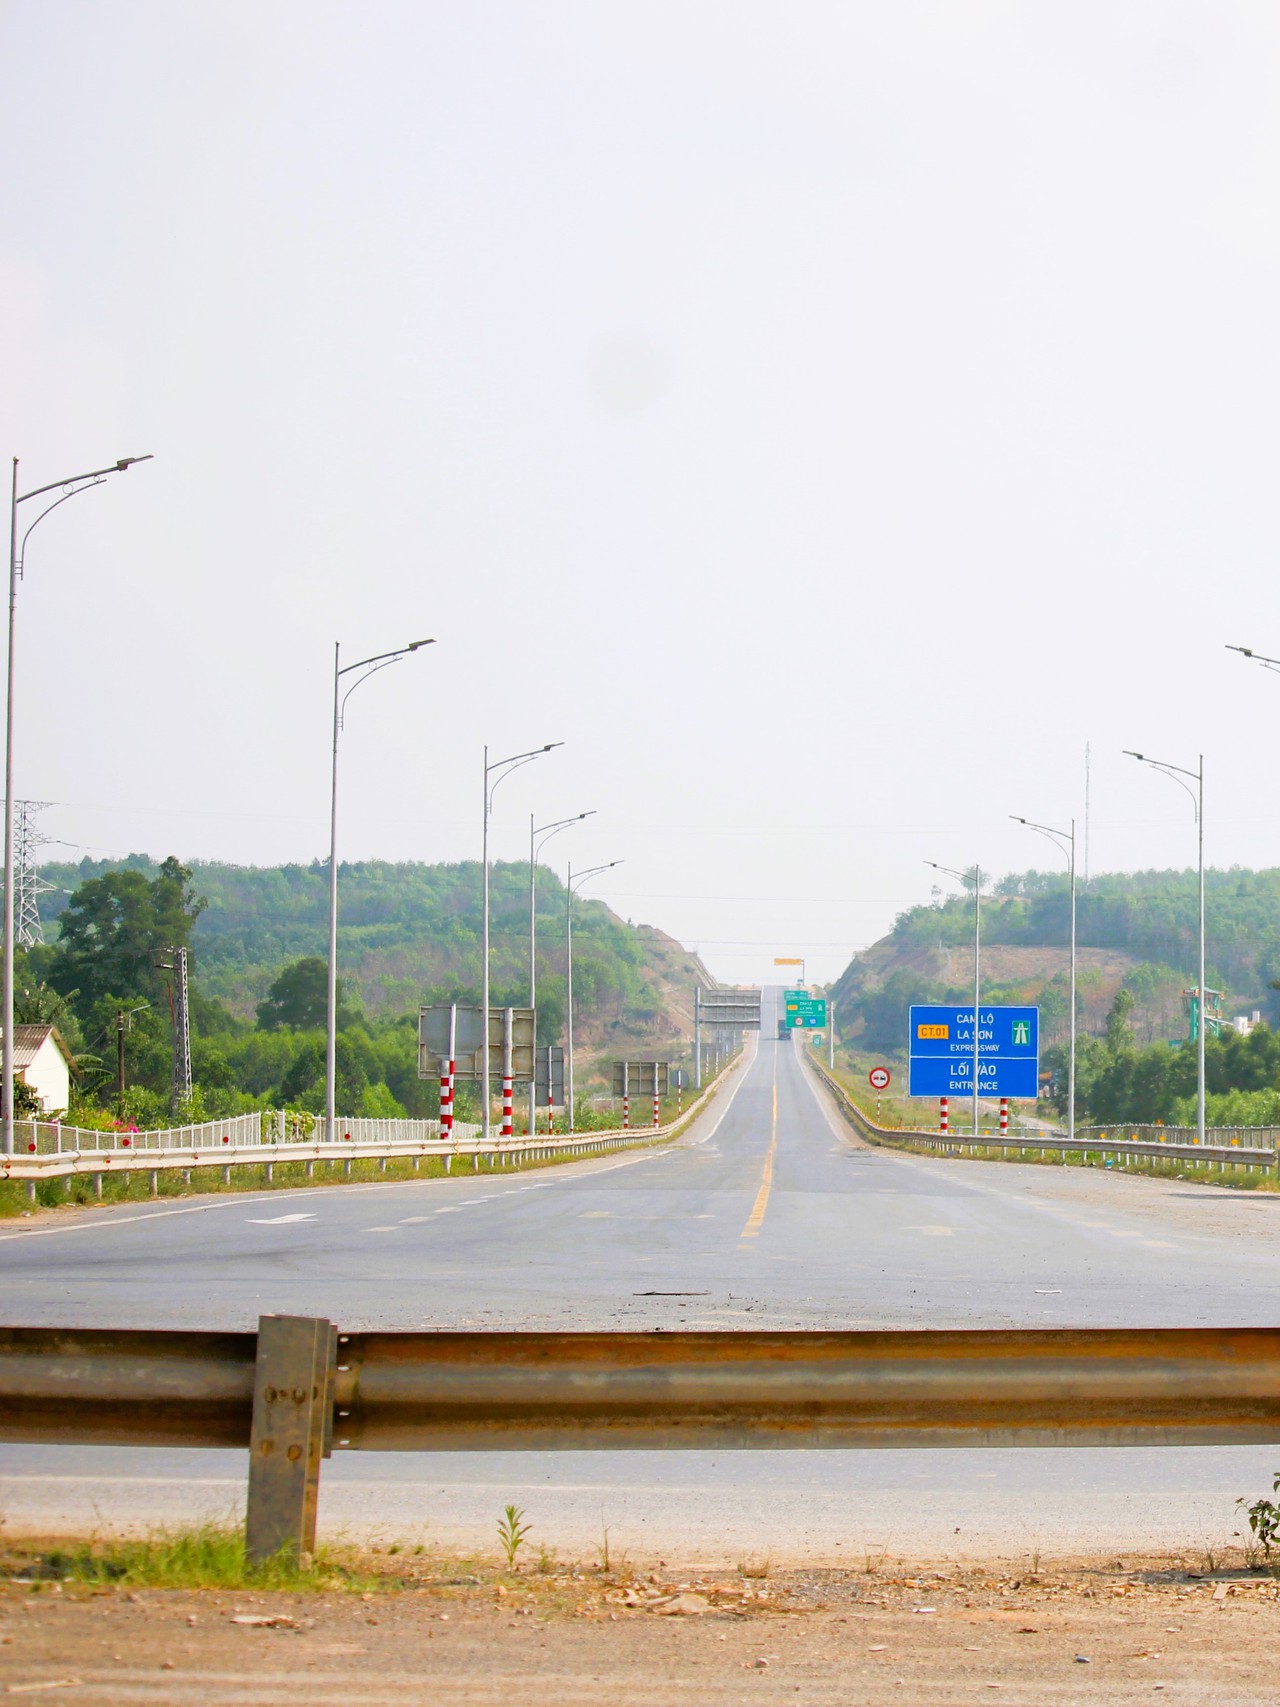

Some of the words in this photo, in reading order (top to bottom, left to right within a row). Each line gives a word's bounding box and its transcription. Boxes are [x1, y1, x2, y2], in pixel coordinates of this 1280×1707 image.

[980, 1013, 994, 1026] LỘ
[921, 1027, 946, 1037] CT.01
[957, 1030, 970, 1040] LA
[950, 1061, 969, 1076] LỐI
